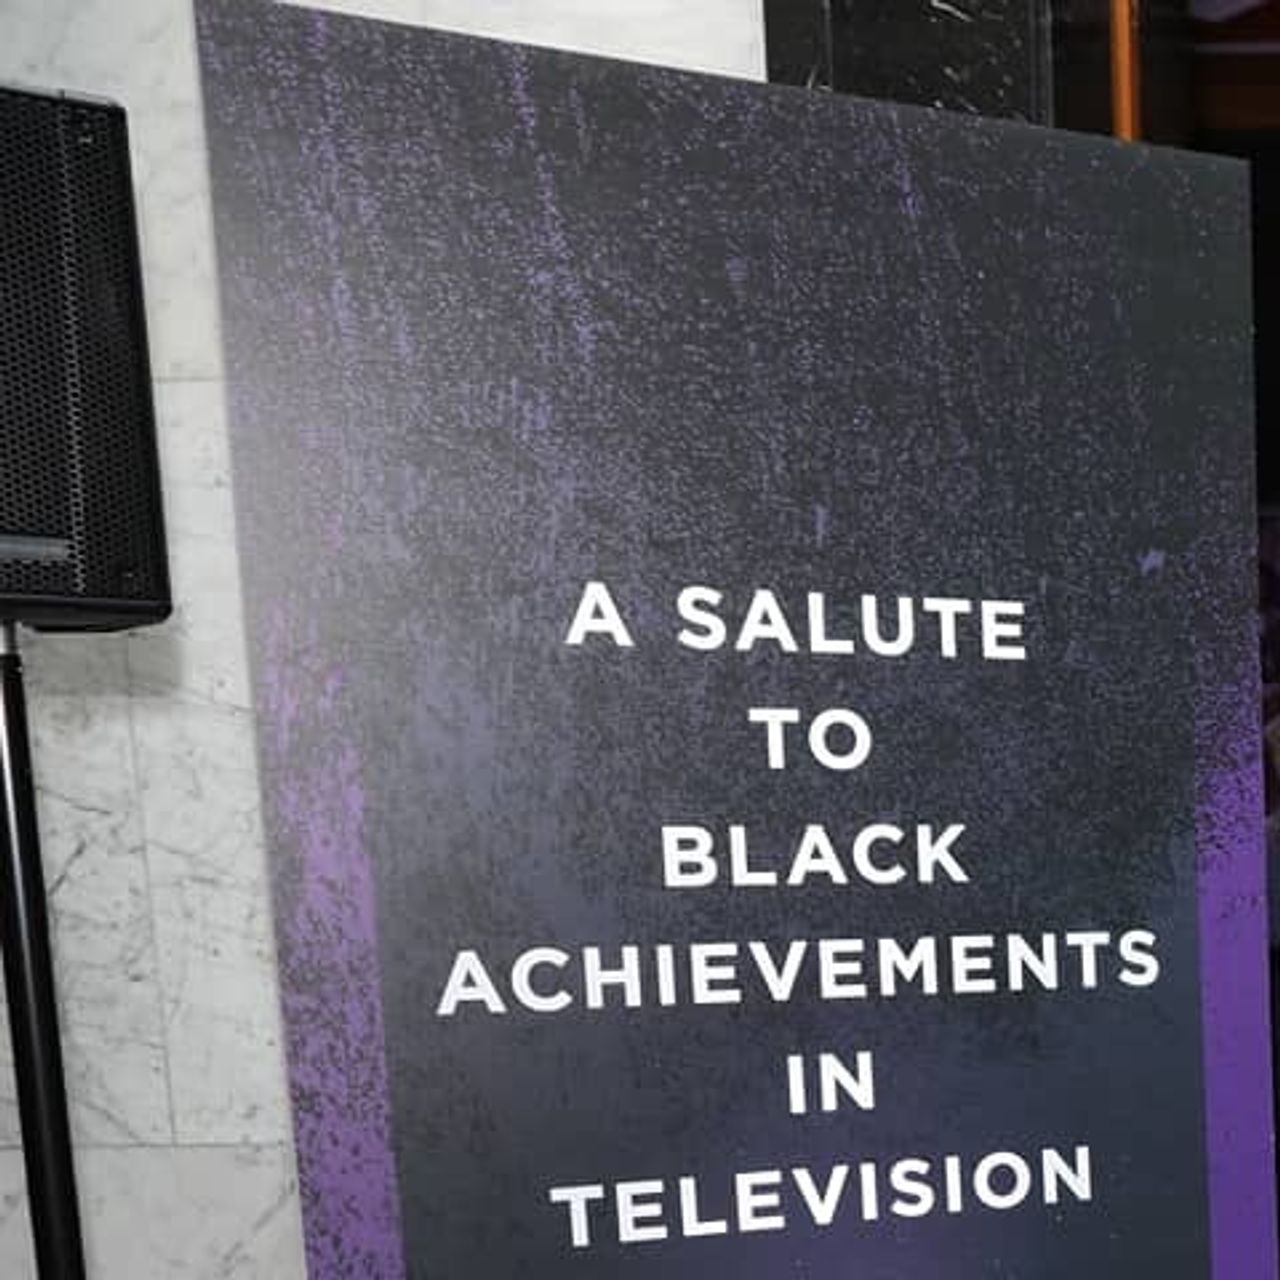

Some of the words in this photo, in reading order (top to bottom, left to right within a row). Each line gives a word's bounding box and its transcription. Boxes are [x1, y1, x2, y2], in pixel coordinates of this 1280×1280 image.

[562, 579, 635, 648] A
[675, 585, 1027, 661] SALUTE
[747, 706, 873, 771] TO
[660, 822, 970, 889] BLACK
[435, 929, 1161, 1017] ACHIEVEMENTS
[786, 1050, 876, 1115] IN
[549, 1144, 1093, 1248] TELEVISION
